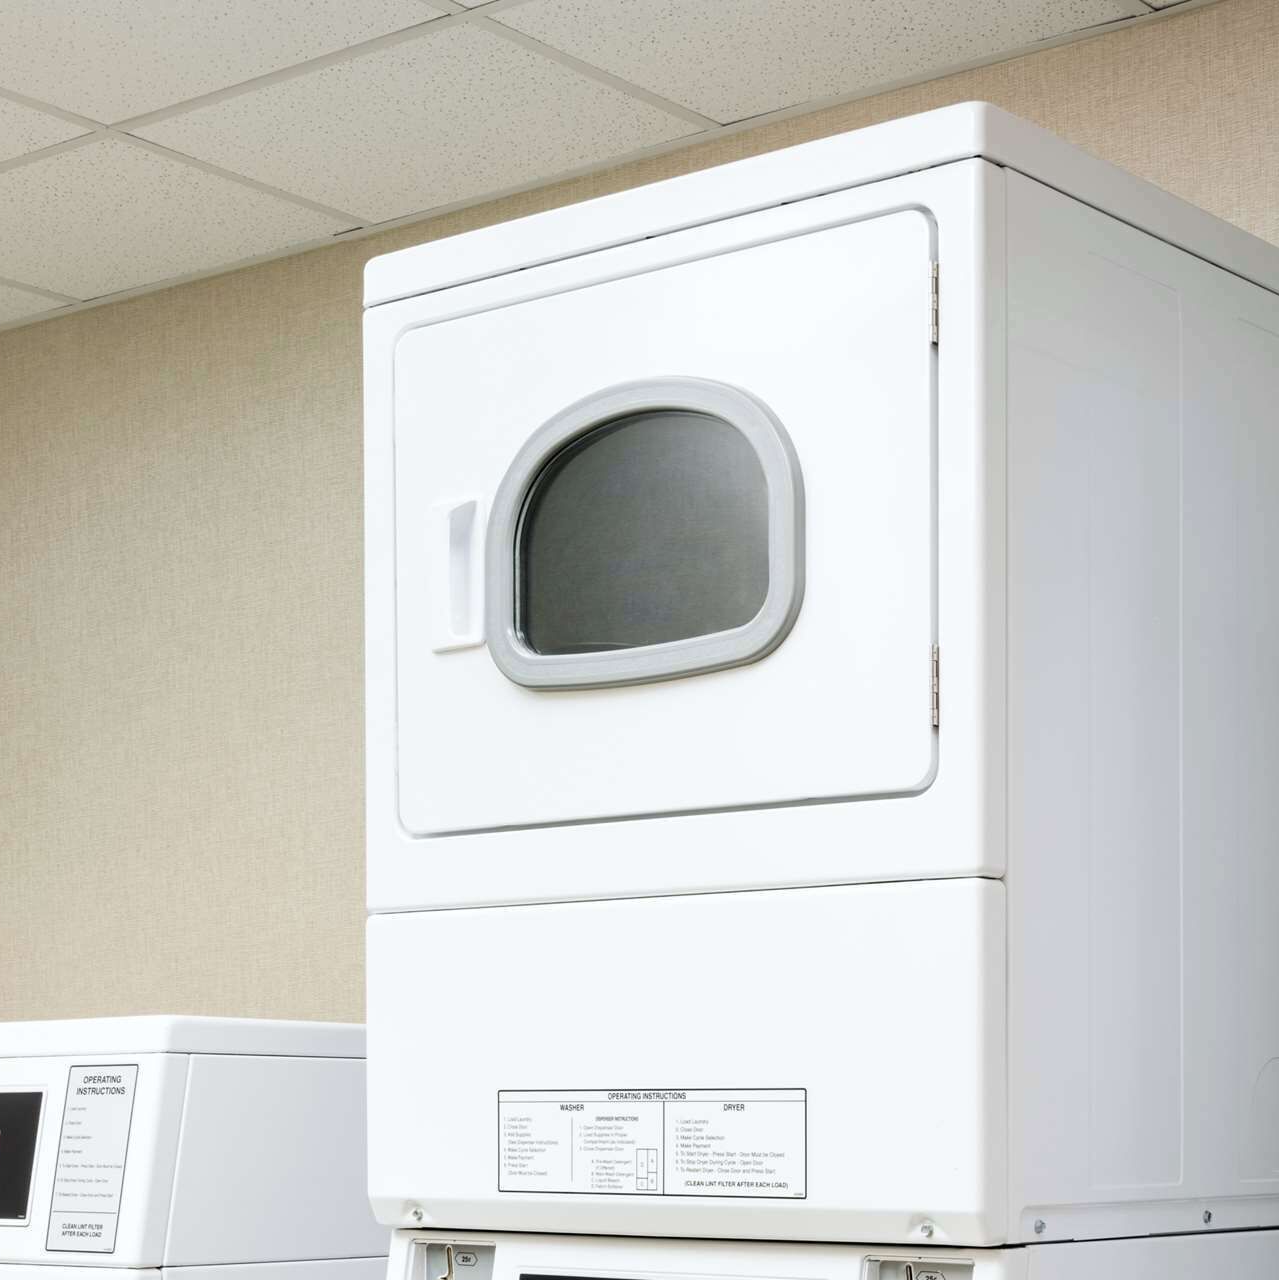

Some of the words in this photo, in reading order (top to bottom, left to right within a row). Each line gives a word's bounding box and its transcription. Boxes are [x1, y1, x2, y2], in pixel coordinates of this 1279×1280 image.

[83, 1076, 122, 1084] OPERATING
[76, 1087, 125, 1095] INSTRUCTIONS
[608, 1092, 641, 1100] OPERATING
[642, 1092, 687, 1100] INSTRUCTIONS
[724, 1104, 745, 1112] DRYER
